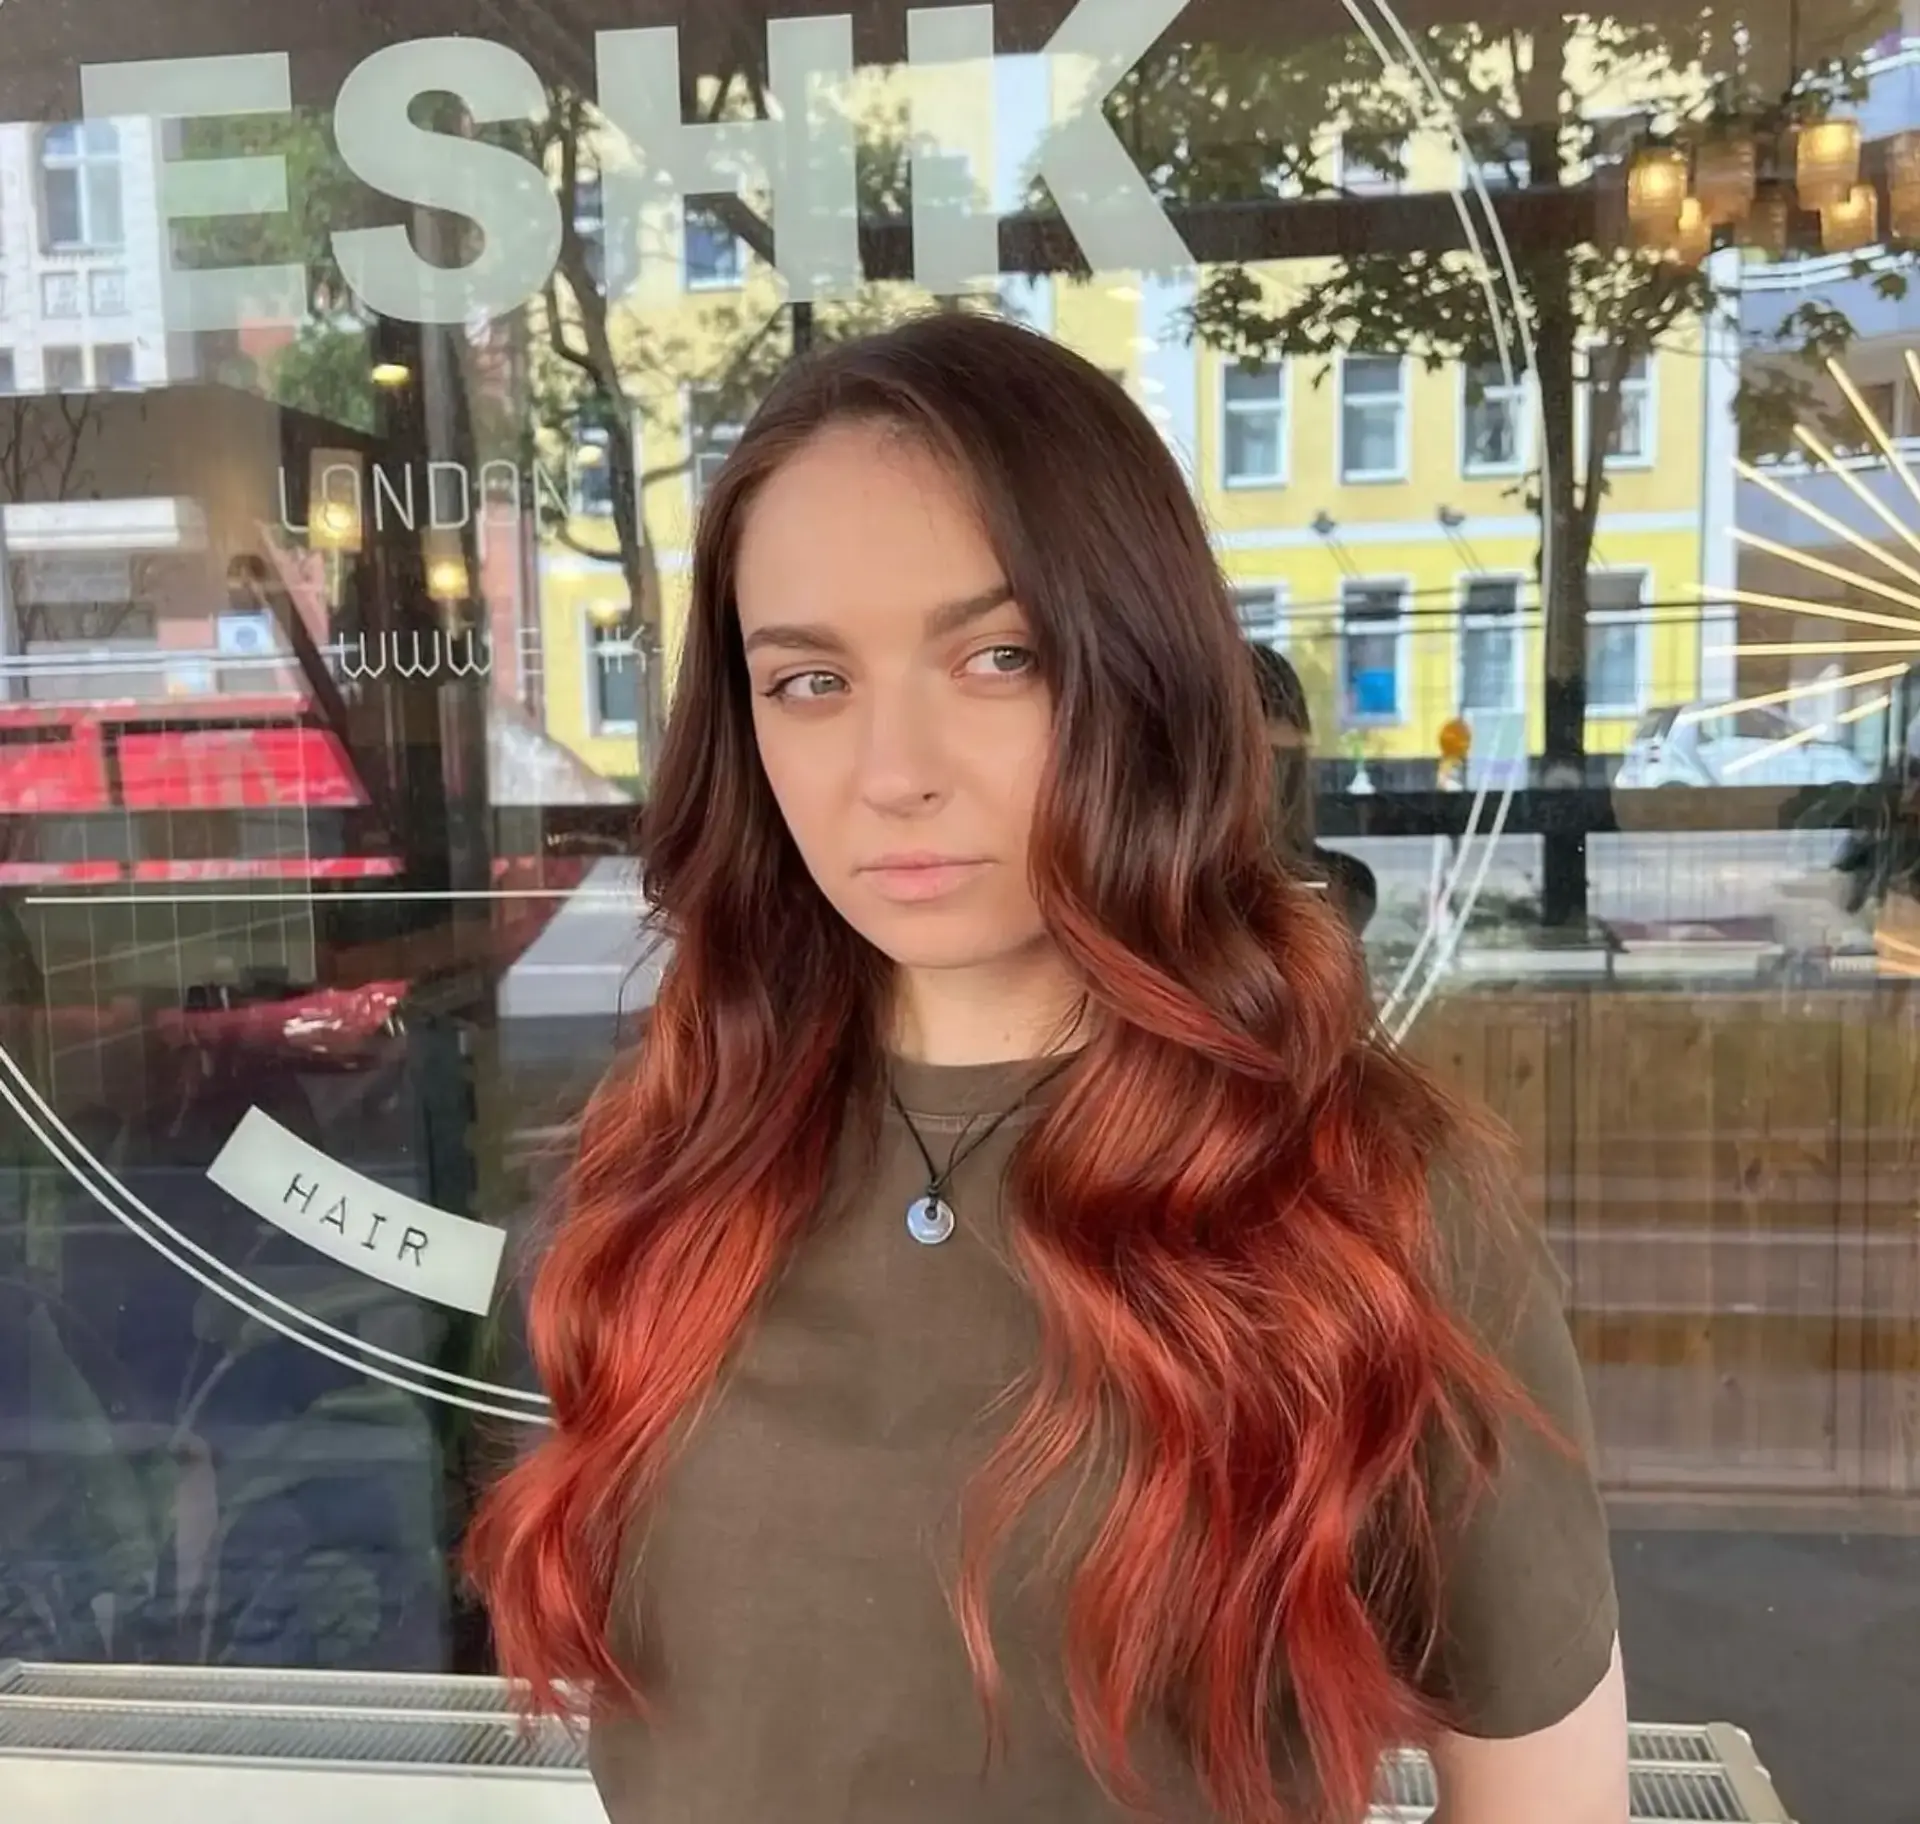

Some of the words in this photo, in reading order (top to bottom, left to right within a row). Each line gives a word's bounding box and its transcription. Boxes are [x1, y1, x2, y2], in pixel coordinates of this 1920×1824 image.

[81, 0, 1197, 331] ESHK
[279, 460, 574, 534] LONDON
[283, 1173, 429, 1267] HAIR
